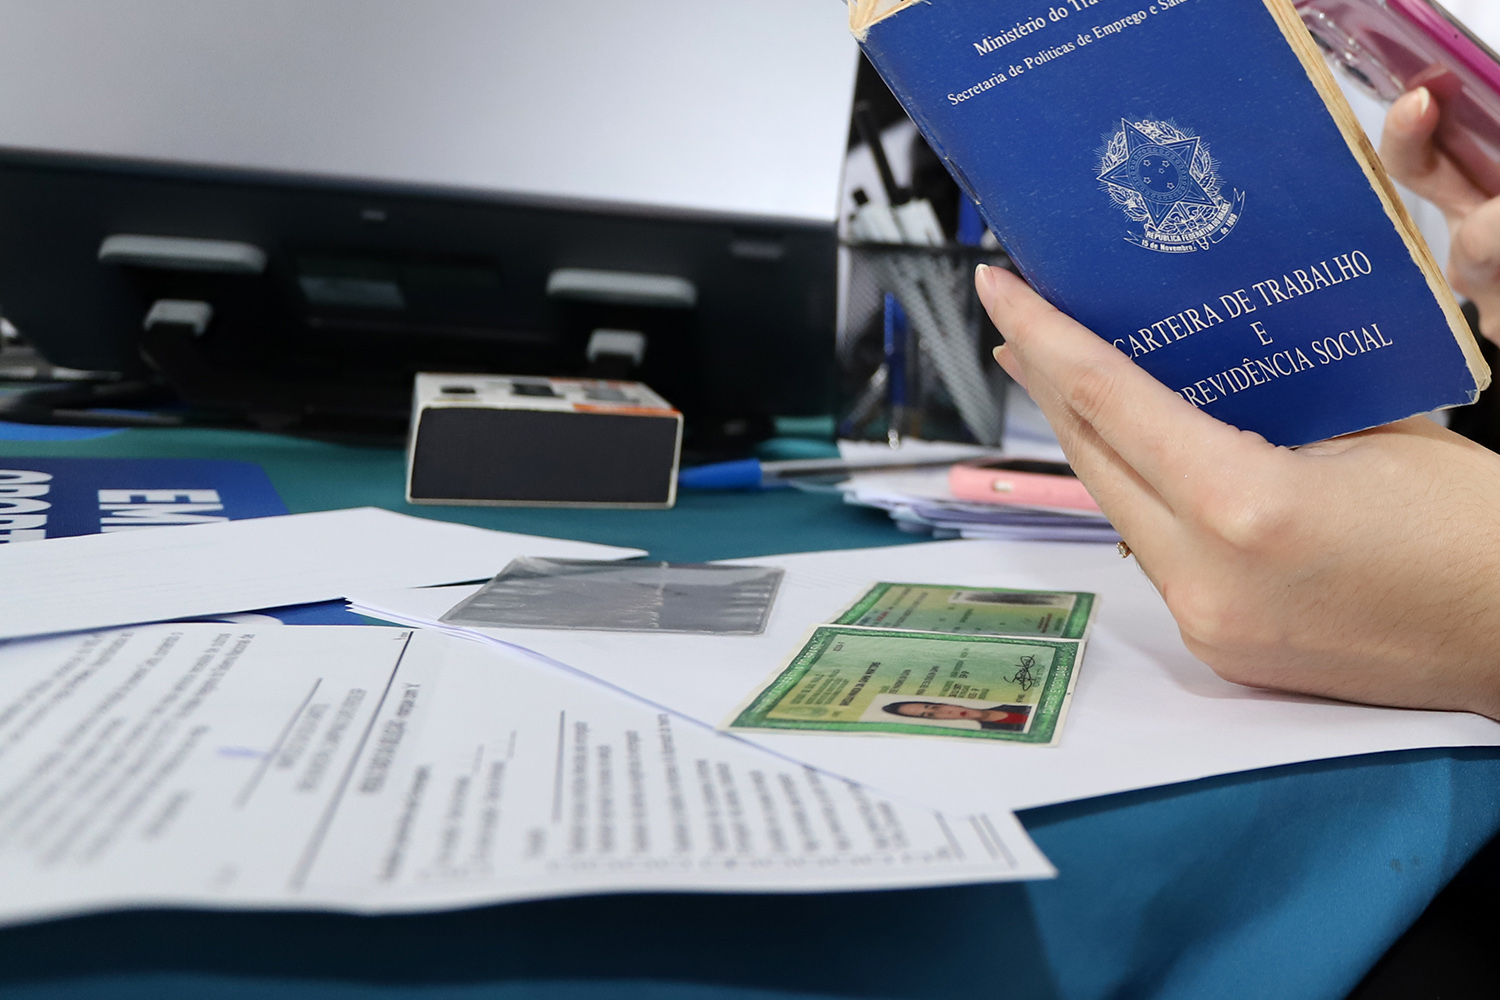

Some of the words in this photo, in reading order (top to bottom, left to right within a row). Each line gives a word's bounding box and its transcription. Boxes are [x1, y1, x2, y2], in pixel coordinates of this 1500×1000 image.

[947, 72, 1007, 106] Secretaria
[1008, 62, 1024, 78] de
[1077, 32, 1093, 47] de
[1091, 9, 1148, 40] Emprego
[1149, 3, 1158, 15] e
[972, 15, 1047, 57] Ministério
[1048, 5, 1069, 23] do
[1141, 239, 1149, 247] 15
[1149, 242, 1158, 250] de
[1219, 288, 1257, 319] DE
[1251, 249, 1373, 307] TRABALHO
[1249, 320, 1274, 346] E
[1310, 322, 1394, 366] SOCIAL
